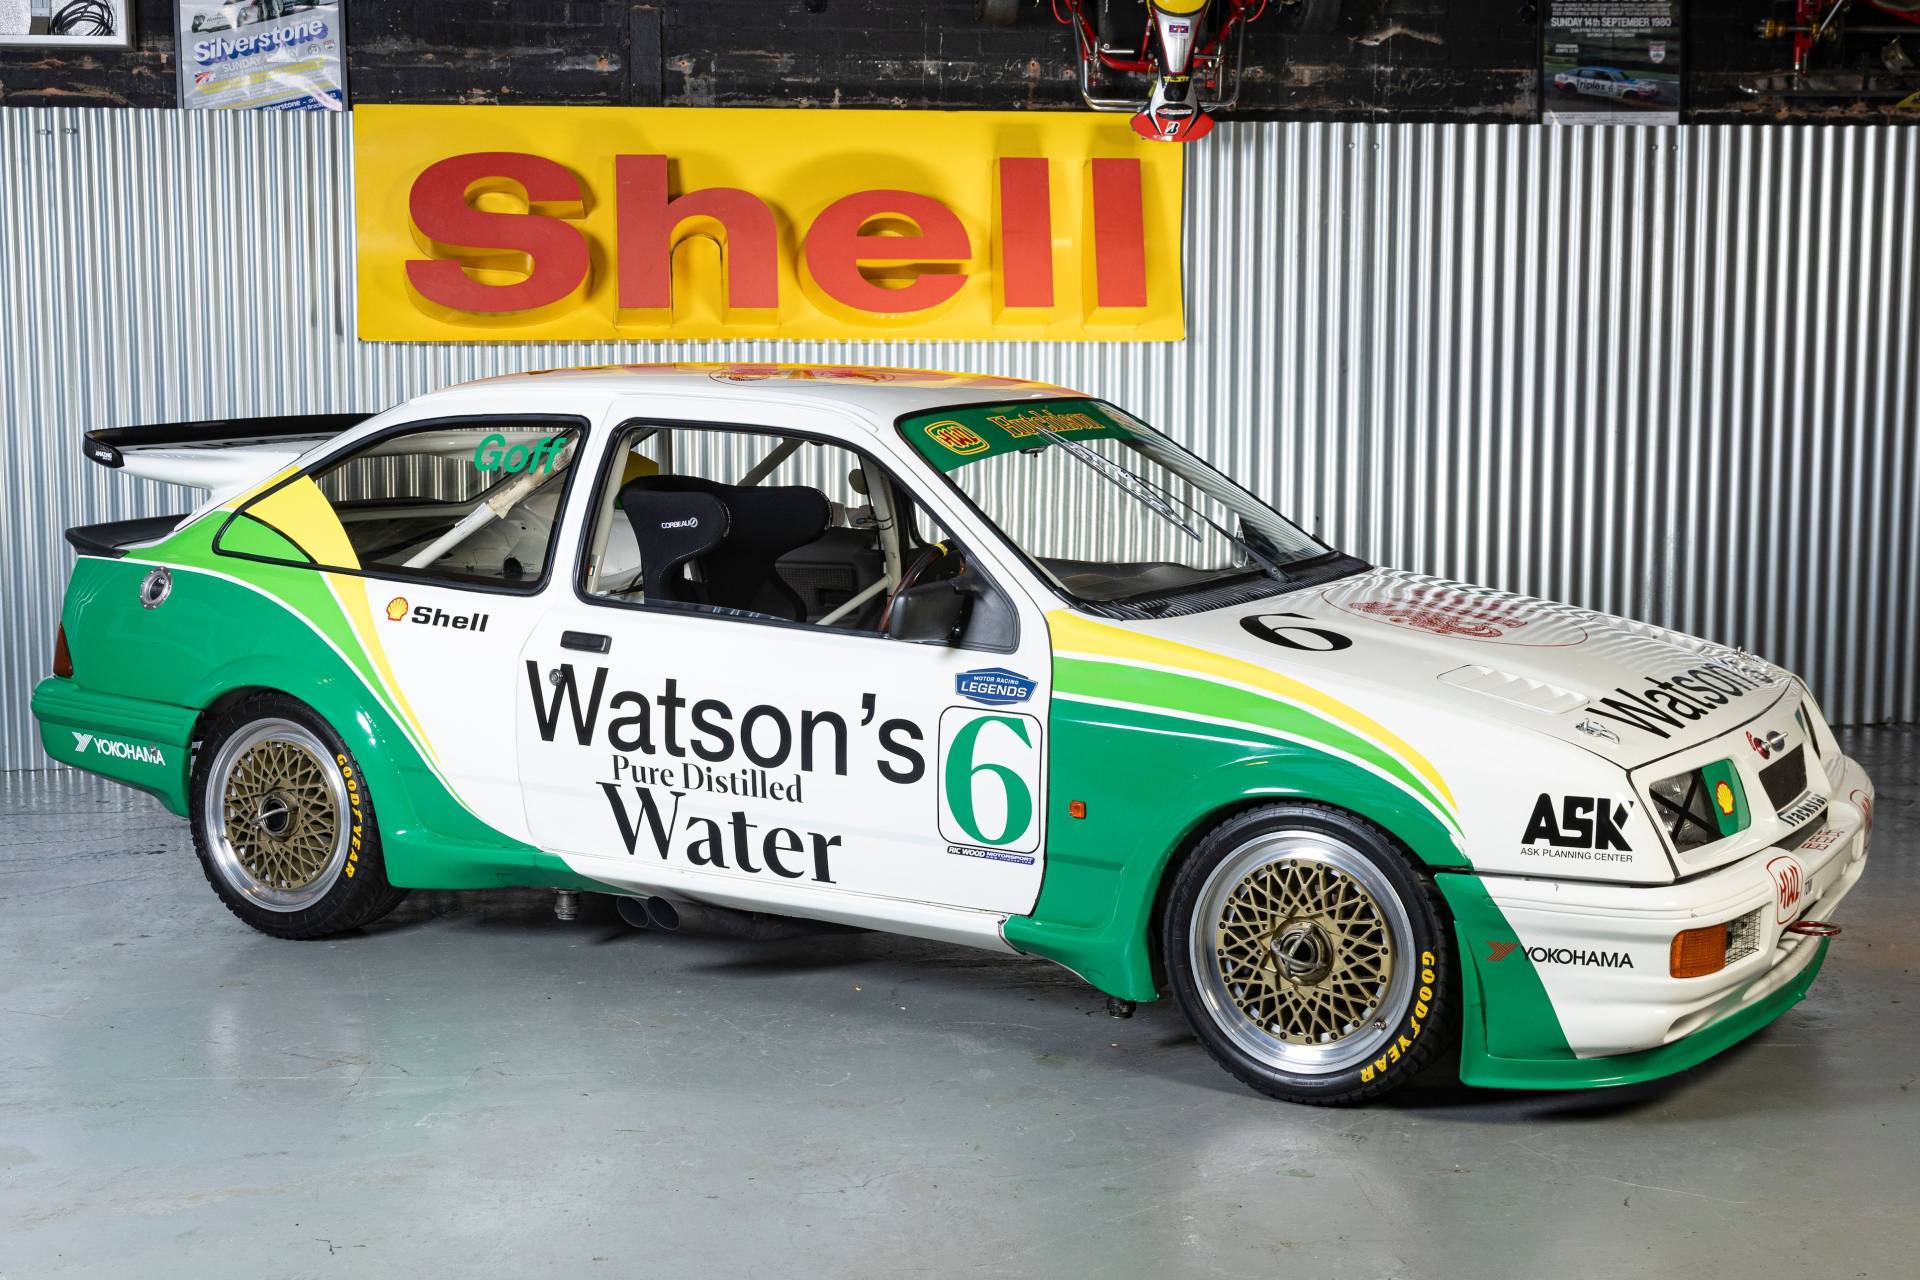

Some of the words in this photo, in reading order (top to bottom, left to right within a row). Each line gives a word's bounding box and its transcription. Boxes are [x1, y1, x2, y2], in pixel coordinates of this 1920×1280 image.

[193, 20, 325, 64] Silverstone
[1550, 17, 1583, 27] SUNDAY
[1584, 17, 1601, 27] 14th
[1601, 17, 1650, 27] SEPTEMBER
[1651, 17, 1672, 27] 1980
[405, 152, 1147, 313] Shell
[474, 433, 567, 475] Goff
[661, 520, 690, 529] CORBEAU
[411, 605, 489, 632] Shell
[1239, 612, 1353, 651] 6
[961, 681, 1027, 698] LEGENDS
[996, 678, 1020, 686] RACING
[526, 660, 926, 784] Watson's
[93, 737, 166, 767] YOKOHAMA
[611, 754, 674, 787] Pure
[681, 762, 804, 803] Distilled
[945, 716, 1033, 845] 6
[337, 754, 362, 878] GOODYEAR
[596, 781, 842, 884] Water
[1521, 792, 1634, 852] ASK
[948, 846, 961, 854] RIC
[962, 848, 986, 858] WOOD
[986, 851, 1033, 862] MOTORSPORT
[1520, 848, 1540, 857] ASK
[1542, 849, 1592, 860] PLANNING
[1594, 852, 1633, 863] CENTER
[1521, 946, 1634, 969] YOKOHAMA
[1360, 951, 1436, 1083] GOODYEAR
